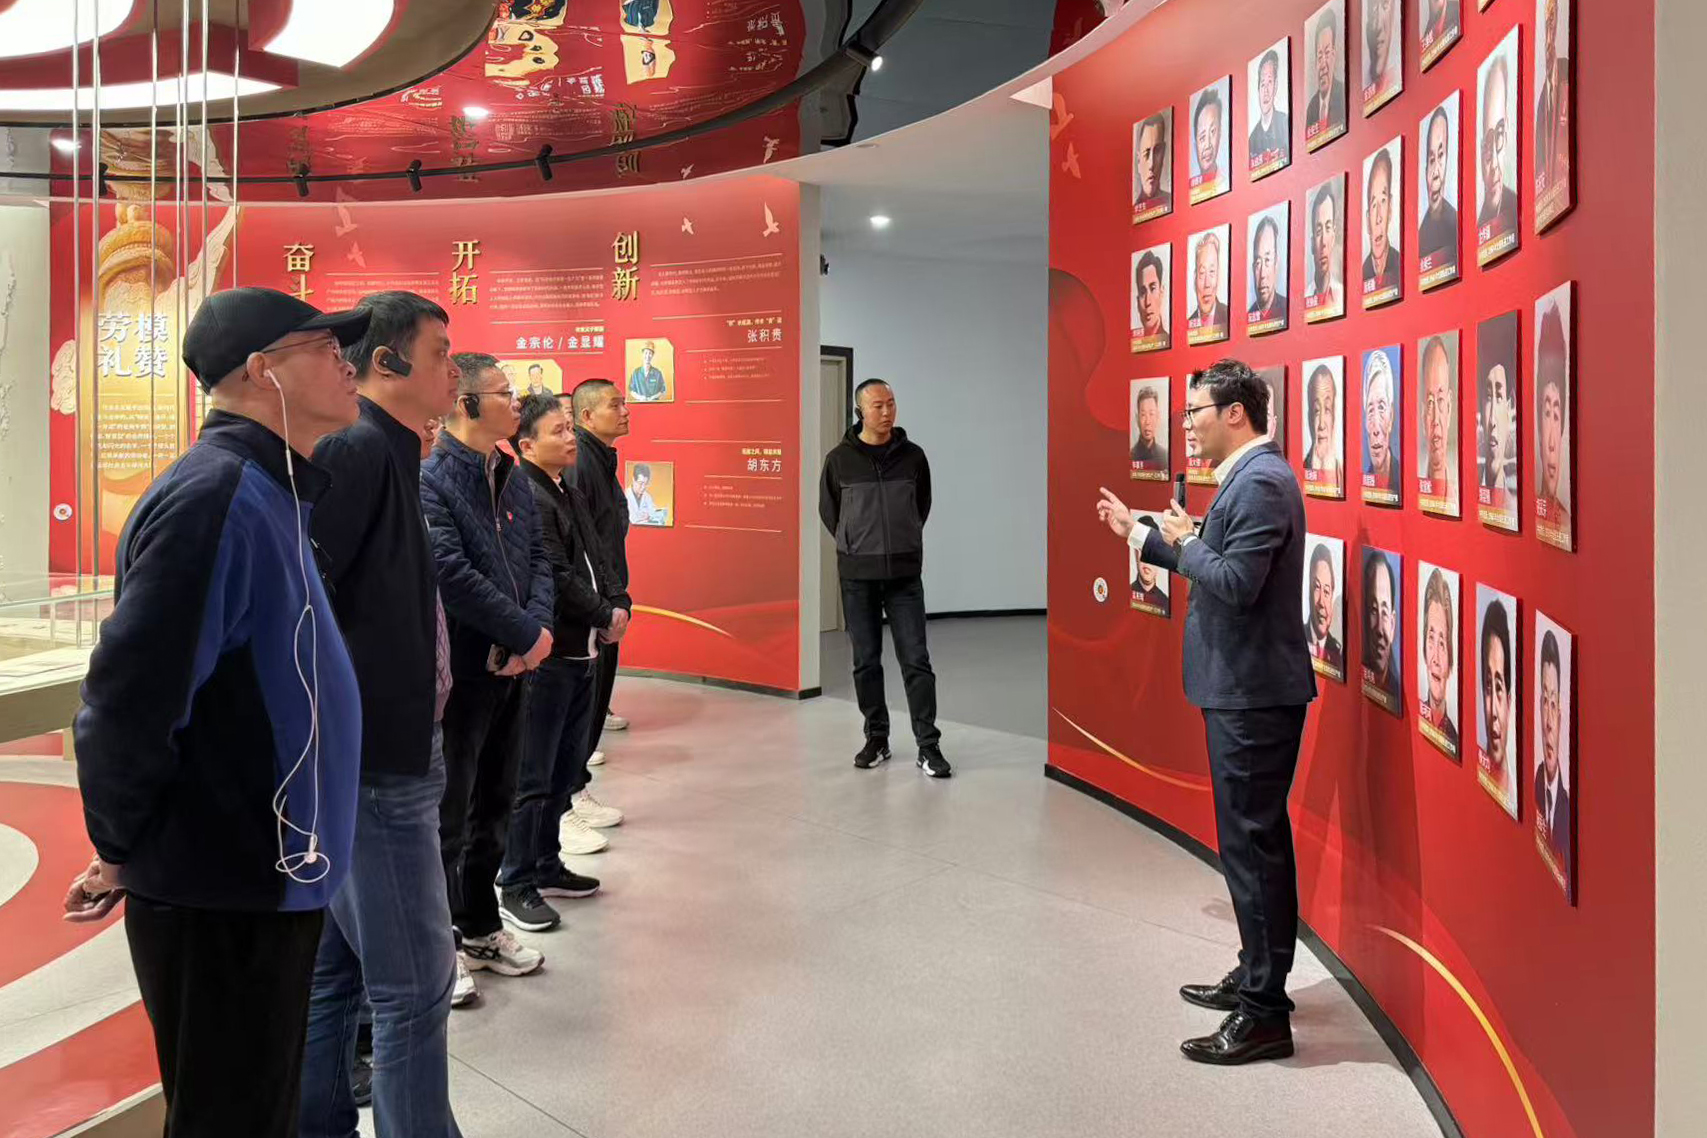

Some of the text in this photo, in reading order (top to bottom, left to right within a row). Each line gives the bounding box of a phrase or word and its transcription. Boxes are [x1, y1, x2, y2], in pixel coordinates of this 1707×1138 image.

[449, 239, 482, 306] 开拓
[611, 231, 641, 301] 创新
[97, 312, 168, 343] 劳模
[747, 328, 782, 343] 张积贵
[96, 346, 168, 379] 礼赞
[747, 458, 782, 472] 胡东方
